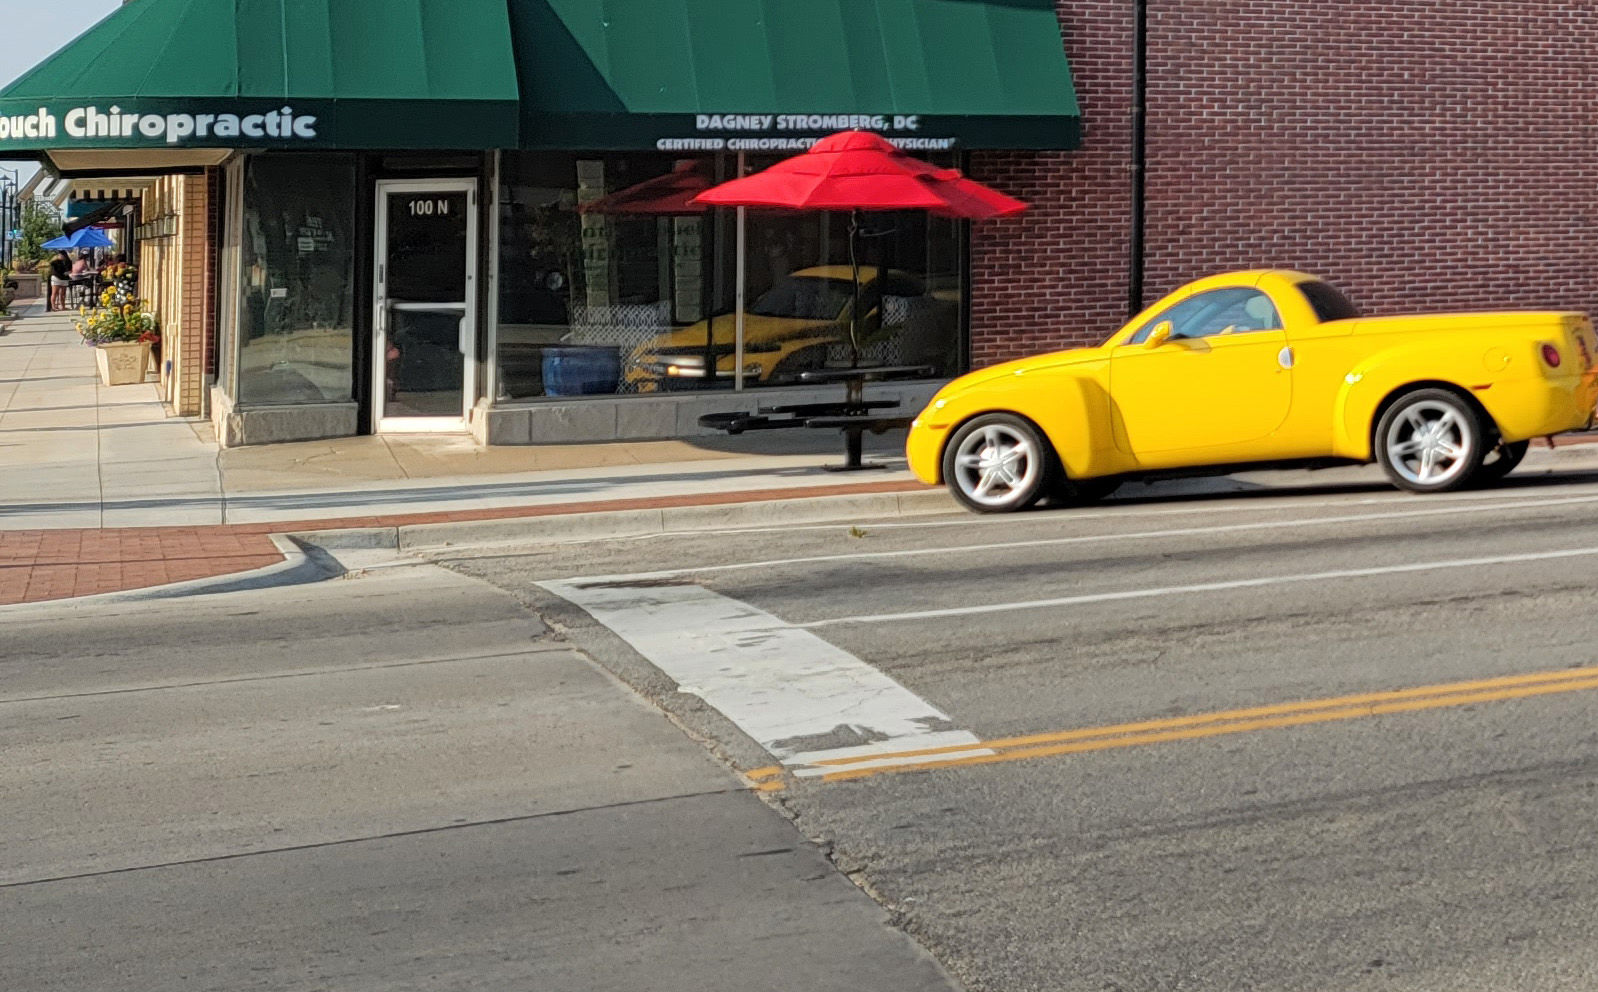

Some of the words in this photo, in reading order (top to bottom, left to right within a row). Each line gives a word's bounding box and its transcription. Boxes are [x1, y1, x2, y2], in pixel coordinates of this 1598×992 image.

[64, 105, 317, 143] Chiropractic
[696, 114, 773, 130] DAGNEY
[776, 114, 889, 132] STROMBERG,
[893, 115, 918, 130] DC
[656, 138, 724, 150] CERTIFIED
[408, 200, 434, 216] 100
[437, 200, 448, 214] N
